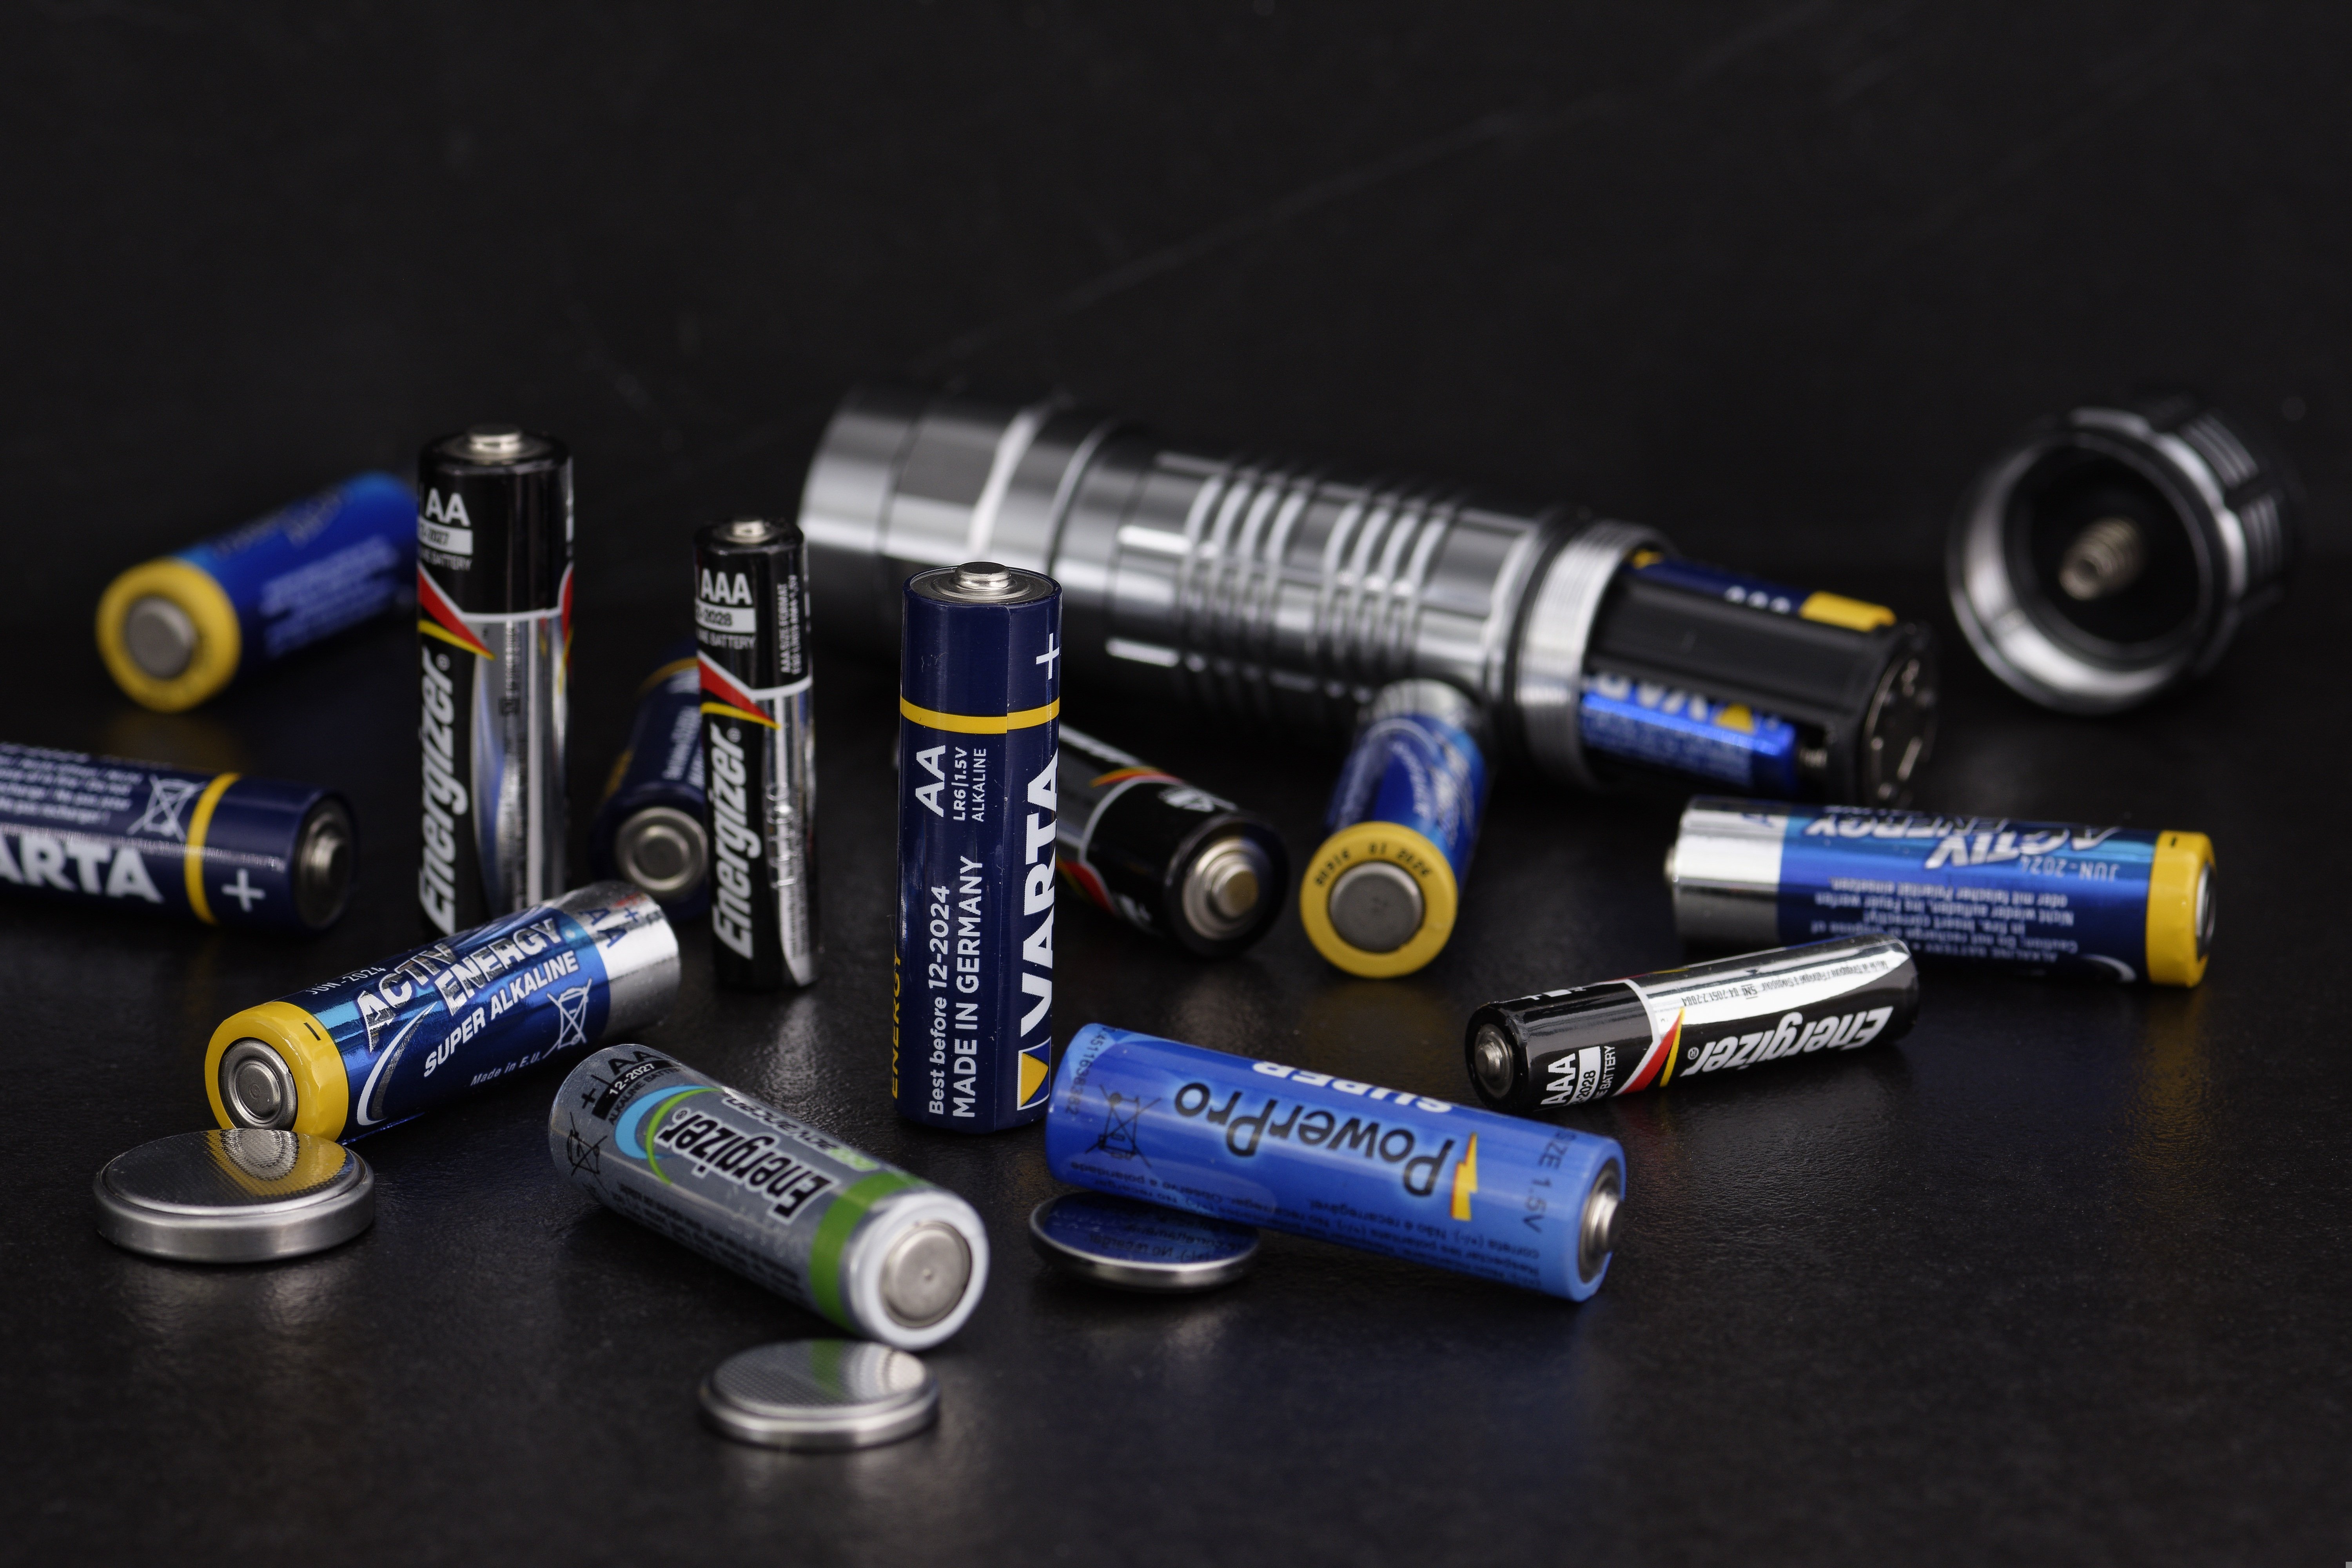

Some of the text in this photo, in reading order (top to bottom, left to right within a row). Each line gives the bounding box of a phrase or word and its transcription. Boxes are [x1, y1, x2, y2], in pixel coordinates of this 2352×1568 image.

[425, 487, 470, 527] AA
[700, 568, 753, 605] AAA
[916, 745, 946, 817] AA
[972, 748, 986, 822] ALKALINE
[1020, 747, 1058, 1038] VARTA
[305, 966, 386, 995] JUN-2024
[434, 918, 564, 1016] ENERGY
[953, 856, 983, 1118] MADE IN GERMANY
[424, 951, 579, 1078] SUPER ALKALINE
[929, 886, 949, 1115] Best before 12-2024
[470, 1068, 501, 1086] Made
[505, 1061, 517, 1073] in
[607, 1051, 658, 1077] AA
[609, 1062, 656, 1097] 12-2027
[1541, 1053, 1576, 1105] AAA
[1599, 1045, 1616, 1094] BATTERY
[608, 1080, 645, 1125] ALKALINE
[1174, 1082, 1455, 1198] PowerPro
